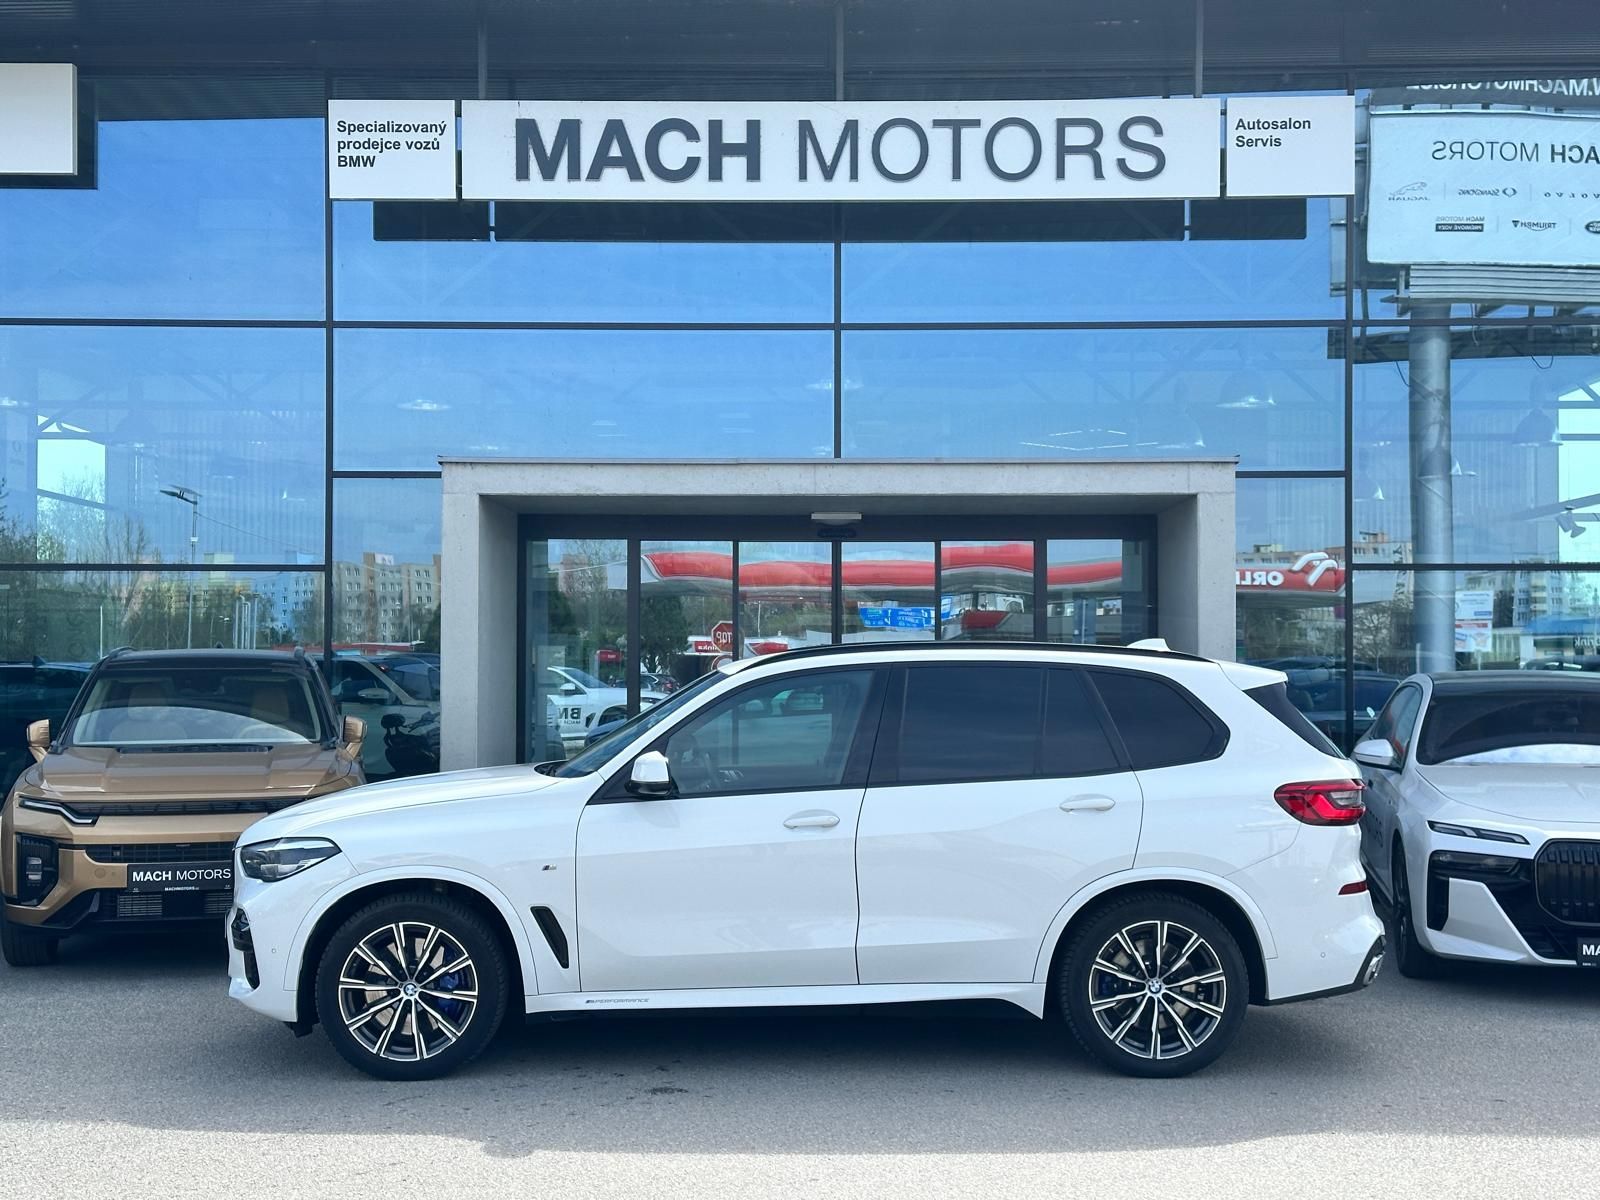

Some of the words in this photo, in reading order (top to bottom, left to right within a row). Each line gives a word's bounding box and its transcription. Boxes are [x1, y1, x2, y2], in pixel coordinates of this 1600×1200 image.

[337, 120, 447, 136] Specializovaný
[1235, 117, 1311, 130] Autosalon
[337, 138, 401, 153] prodejce
[405, 138, 440, 150] vozů
[1235, 135, 1282, 148] Servis
[515, 117, 762, 183] MACH
[799, 115, 1166, 183] MOTORS
[337, 155, 376, 168] BMW
[132, 870, 172, 882] MACH
[176, 868, 232, 881] MOTORS
